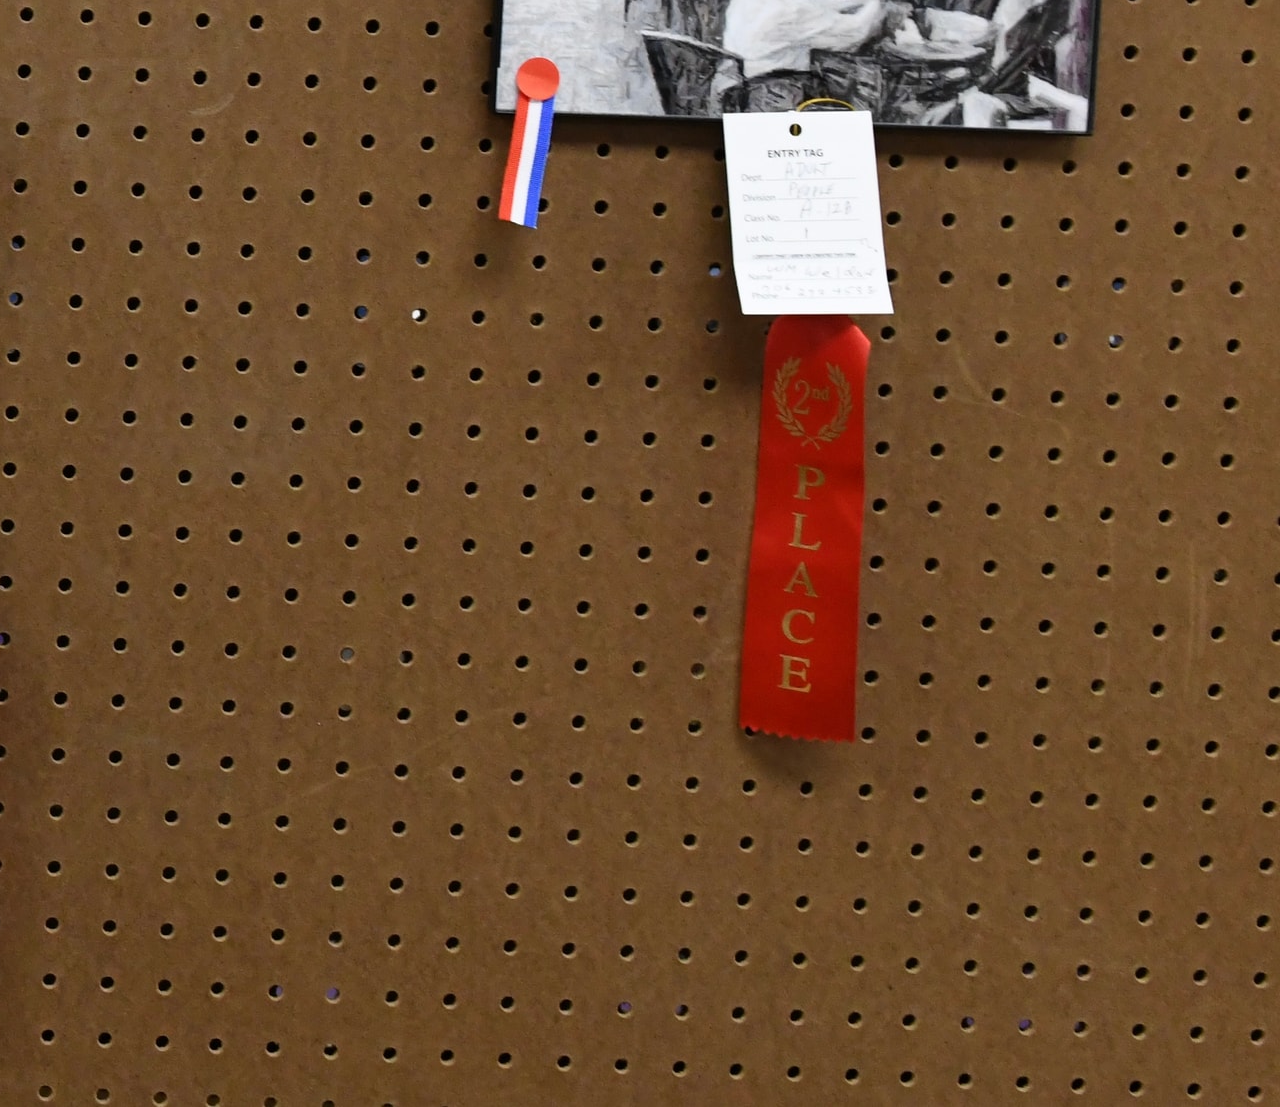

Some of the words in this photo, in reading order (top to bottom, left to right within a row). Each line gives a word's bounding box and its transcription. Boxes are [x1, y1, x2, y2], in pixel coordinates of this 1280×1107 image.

[767, 149, 801, 158] ENTRY
[803, 149, 824, 157] TAG
[793, 378, 831, 416] 2nd
[776, 463, 825, 694] PLACE
